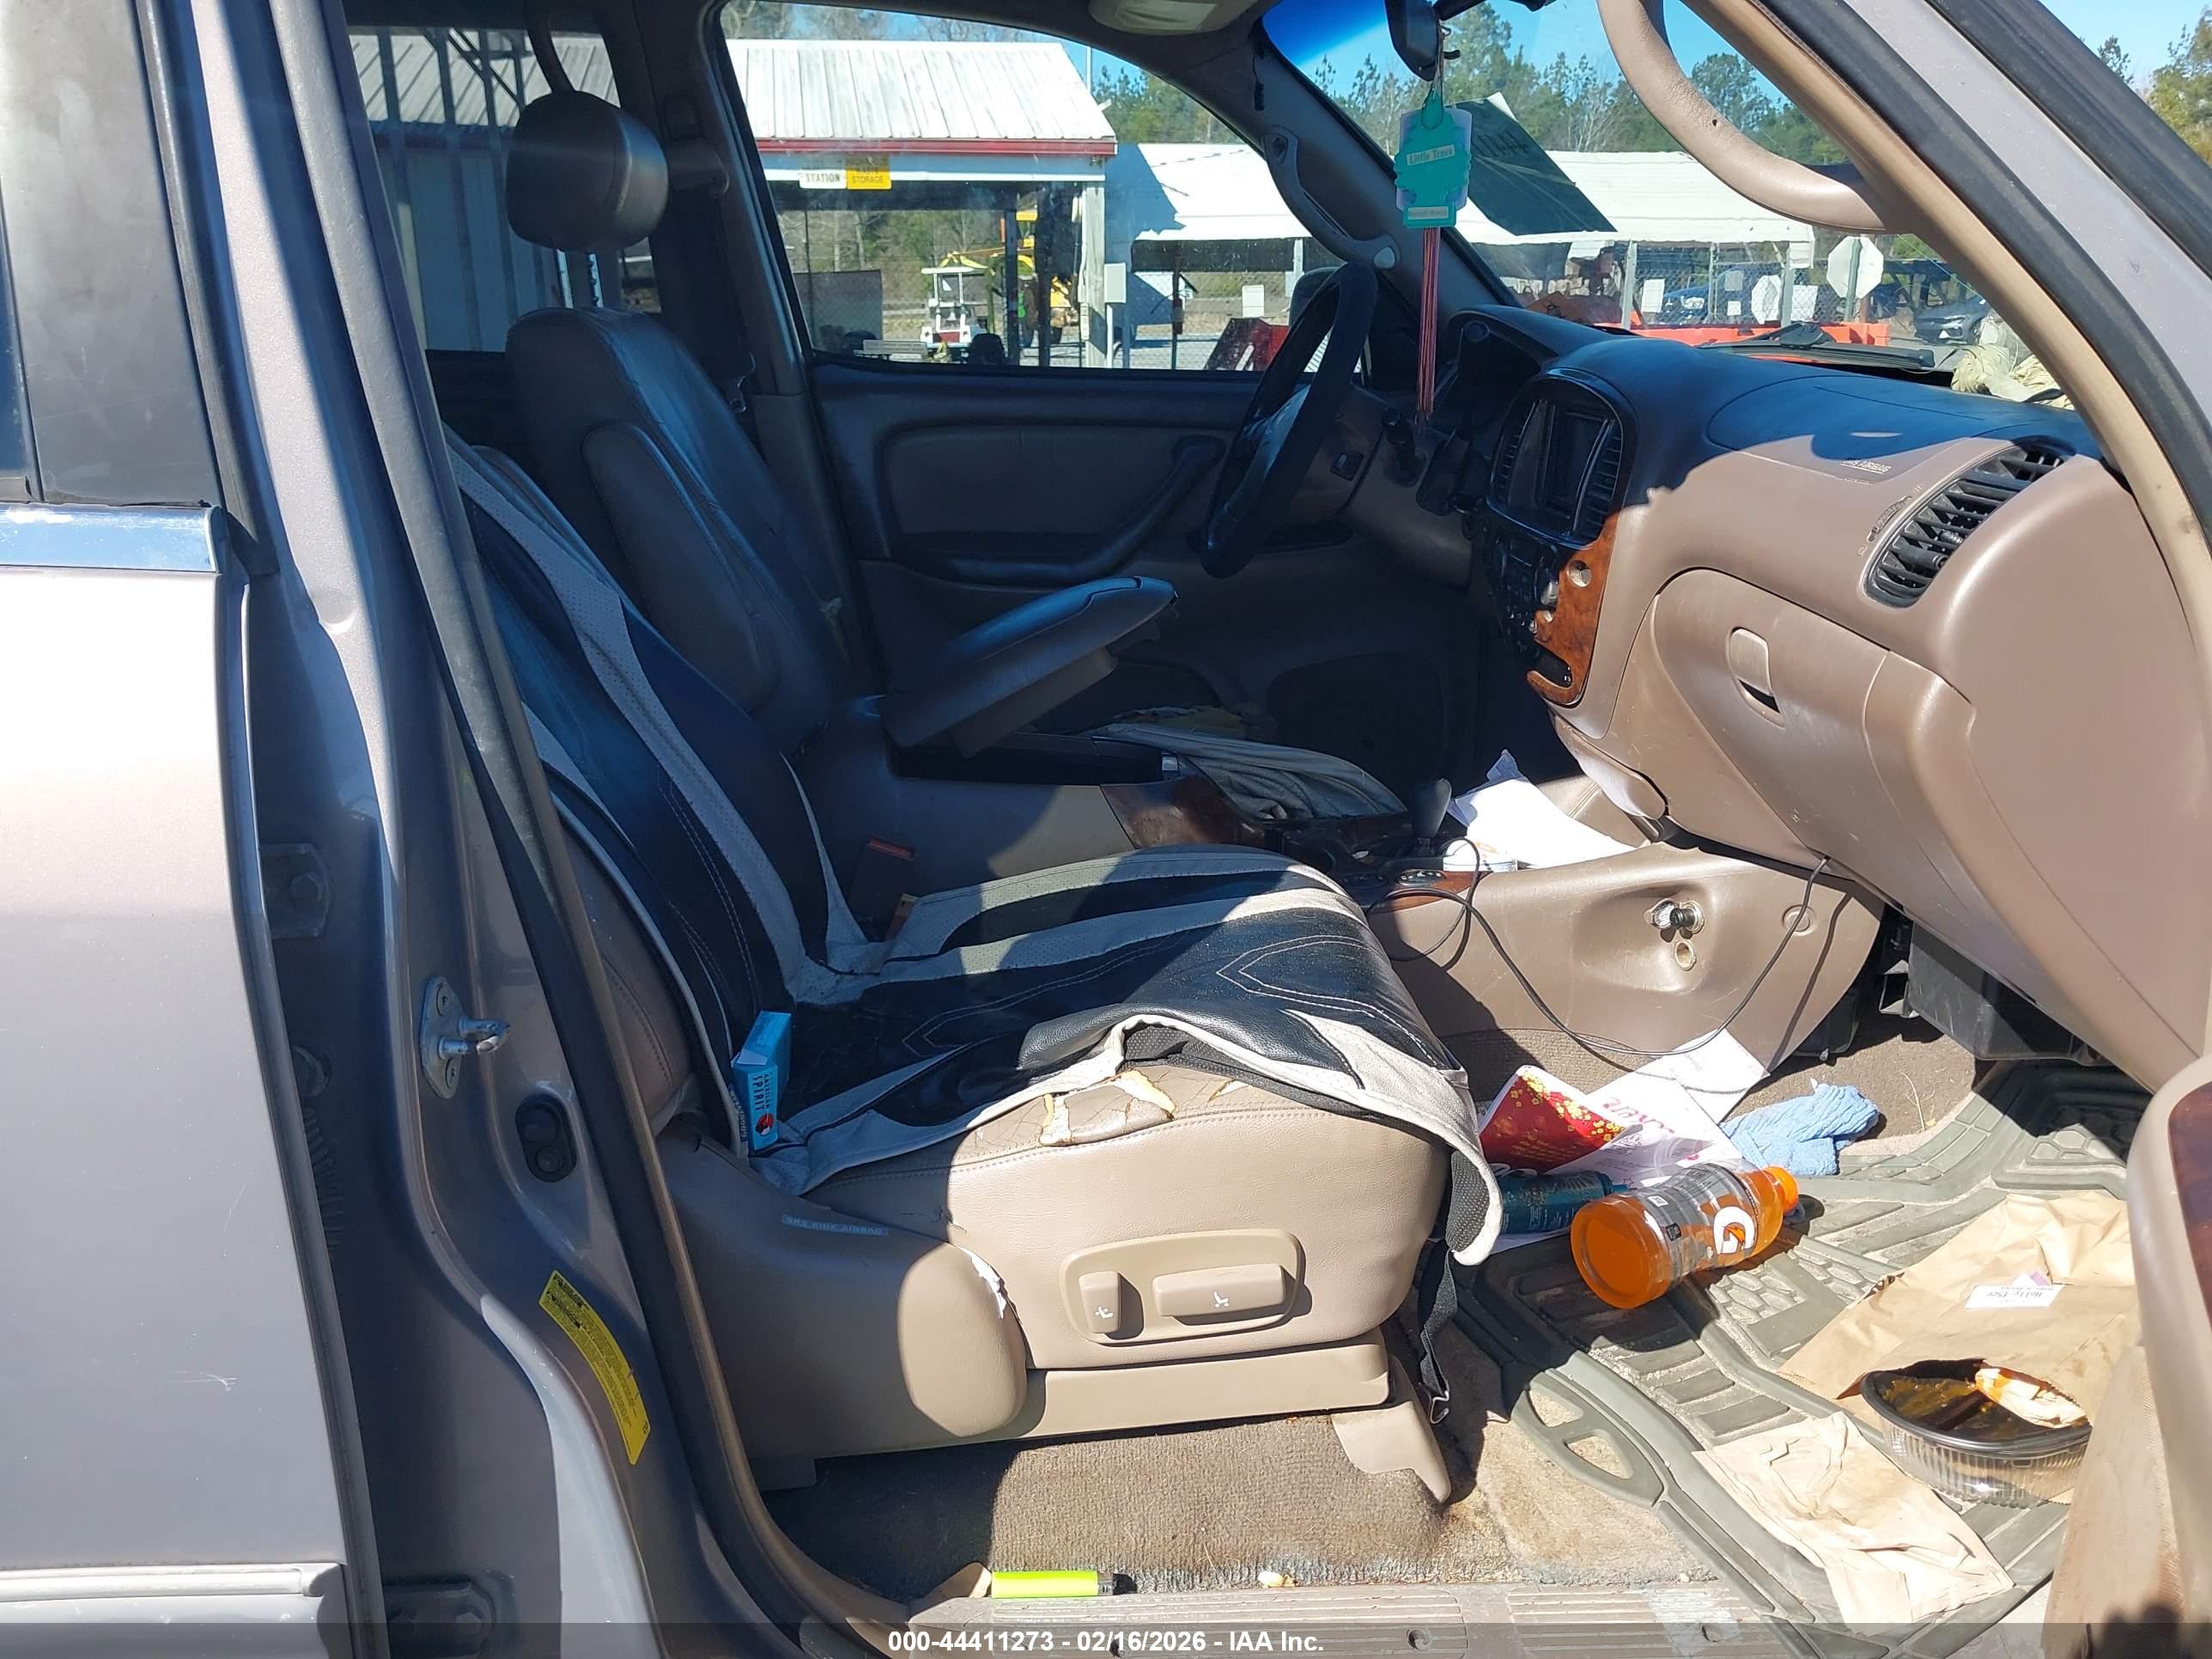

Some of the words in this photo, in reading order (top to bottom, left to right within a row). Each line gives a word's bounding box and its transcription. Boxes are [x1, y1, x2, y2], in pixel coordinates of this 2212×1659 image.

[806, 173, 841, 183] STATION
[852, 175, 884, 184] STORAGE
[752, 1075, 765, 1111] SPIRIT
[1713, 1206, 1756, 1255] G
